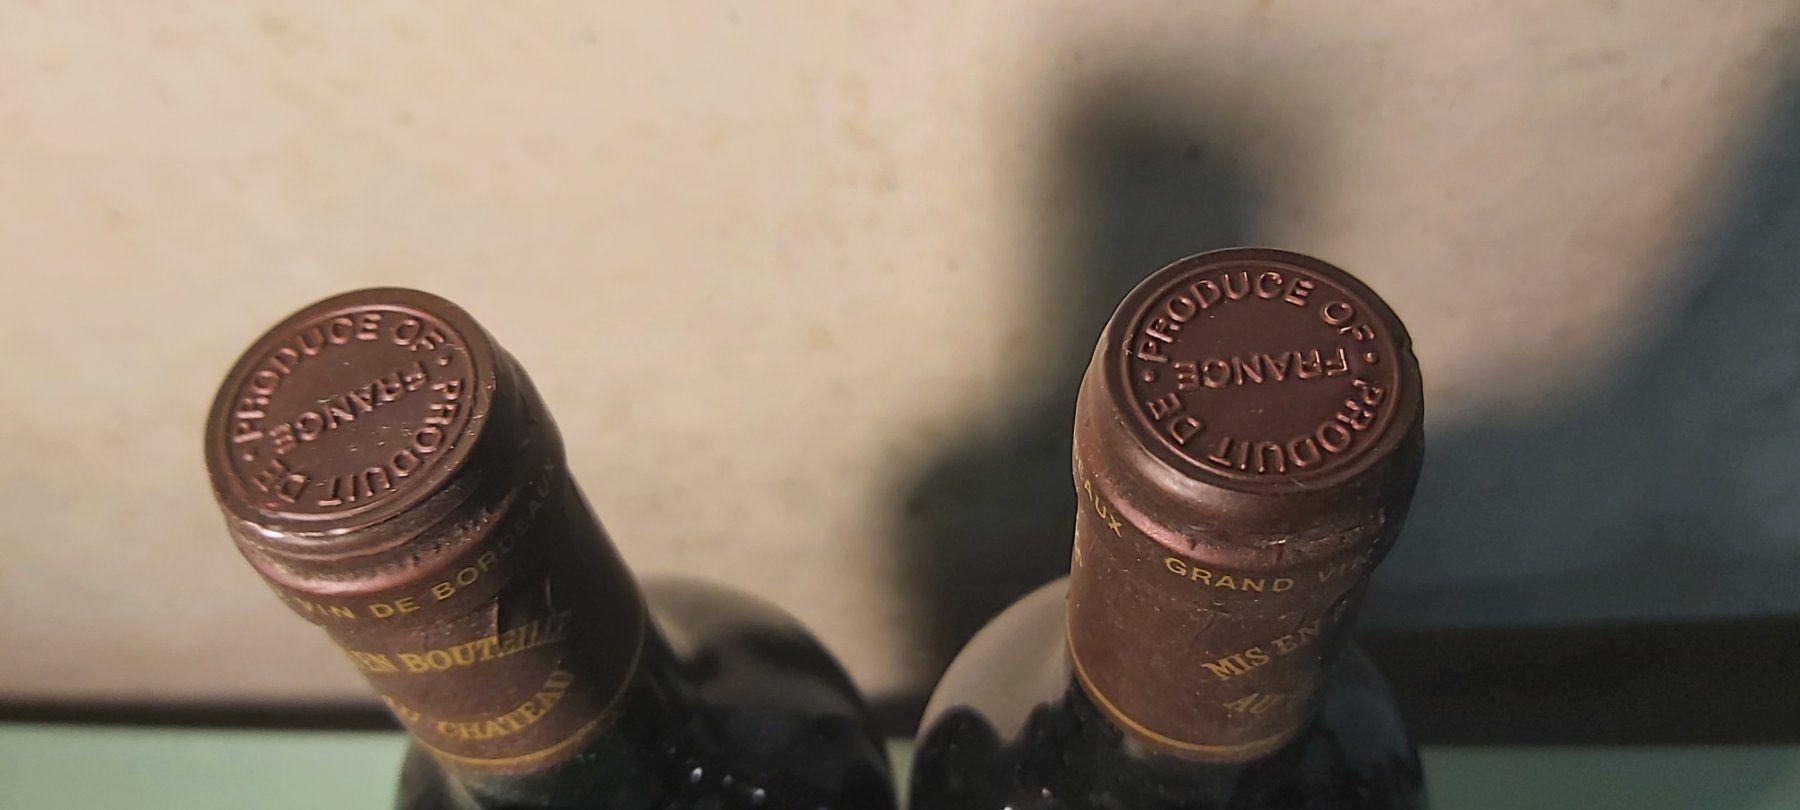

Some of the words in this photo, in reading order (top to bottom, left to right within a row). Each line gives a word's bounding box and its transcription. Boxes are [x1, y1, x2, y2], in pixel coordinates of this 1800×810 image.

[1136, 270, 1316, 364] PRODUCE
[1320, 301, 1375, 342] OF
[233, 312, 382, 444] PRODUCE
[393, 317, 446, 352] OF
[269, 360, 429, 455] FRANCE
[1172, 347, 1349, 389] FRANCE
[317, 379, 465, 508] PRODUIT
[1147, 391, 1204, 446] DE
[1208, 378, 1385, 474] PRODUIT
[253, 458, 309, 503] DE
[368, 596, 421, 619] DE
[431, 458, 556, 601] BORDEAUX
[1164, 555, 1294, 593] GRAND
[397, 608, 572, 675] BOUTEILLE
[1200, 646, 1270, 681] MIS
